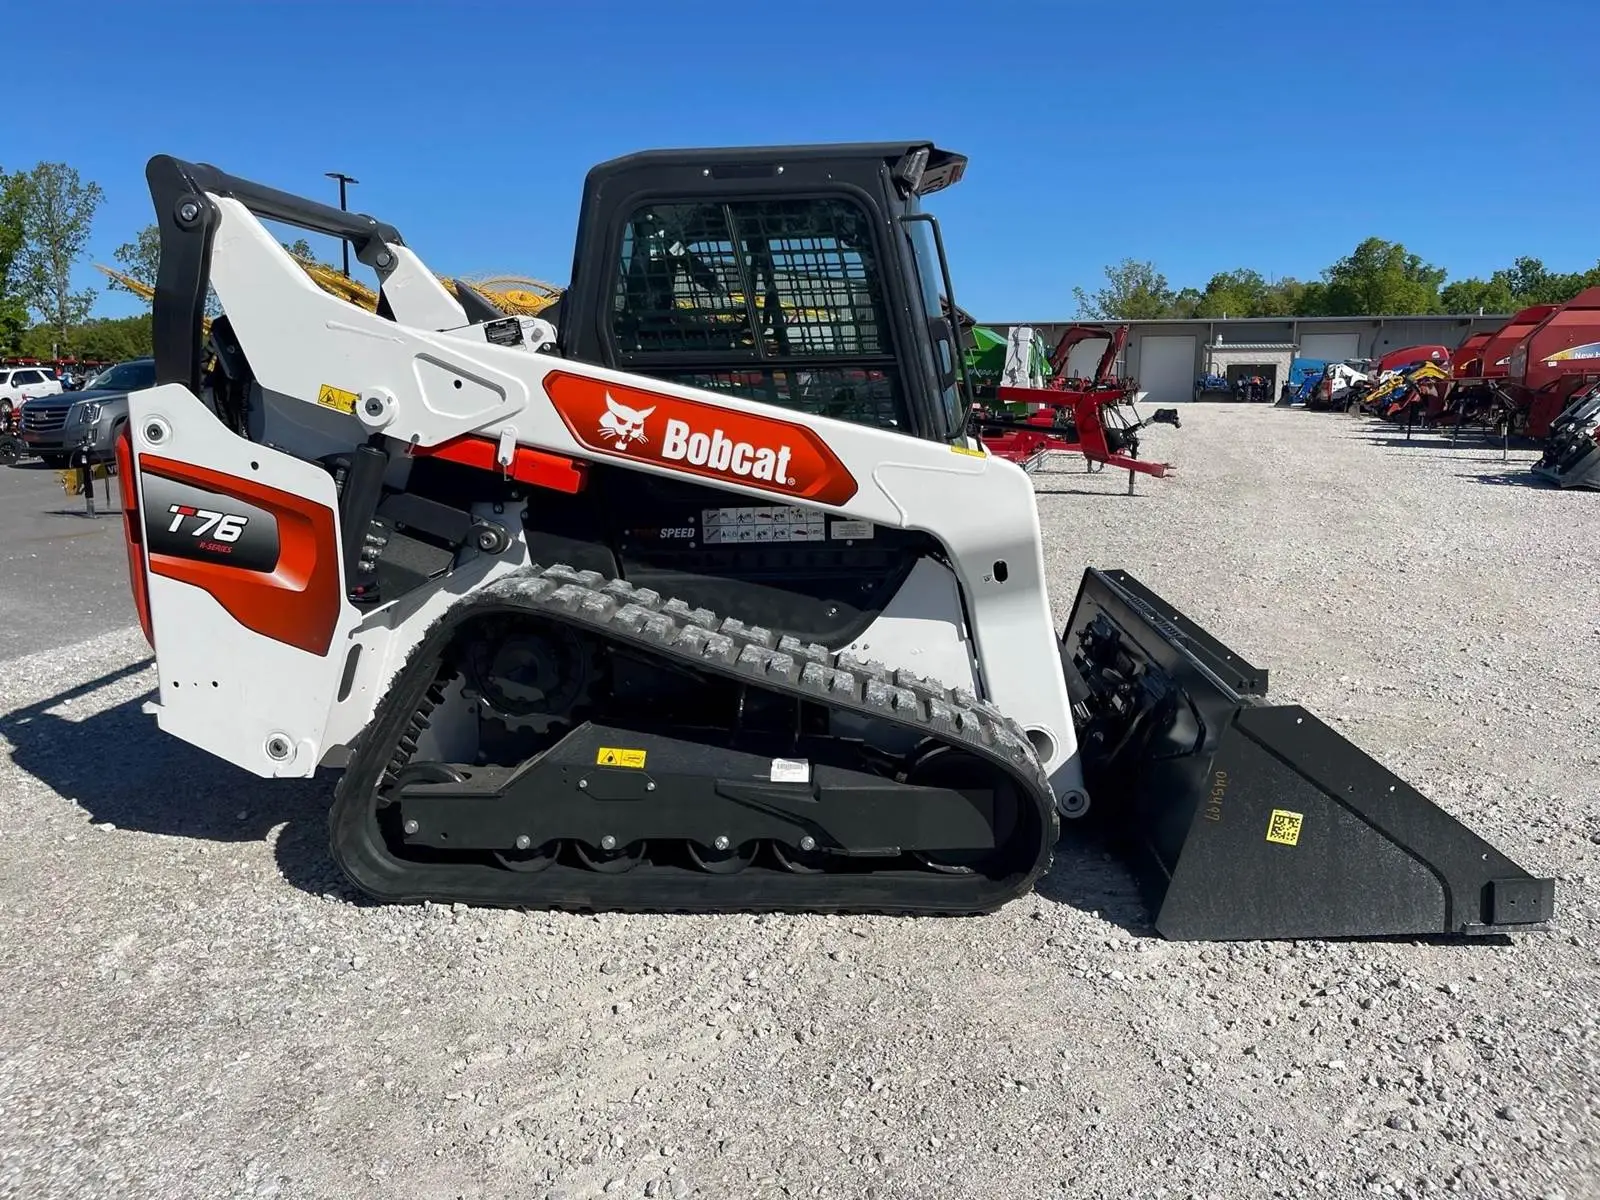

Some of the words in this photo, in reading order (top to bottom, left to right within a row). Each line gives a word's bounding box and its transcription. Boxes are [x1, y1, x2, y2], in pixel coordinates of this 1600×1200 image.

[1574, 351, 1594, 359] New
[661, 418, 791, 485] Bobcat
[167, 504, 249, 543] T76
[660, 528, 695, 539] SPEED
[199, 542, 233, 553] R-SERIES
